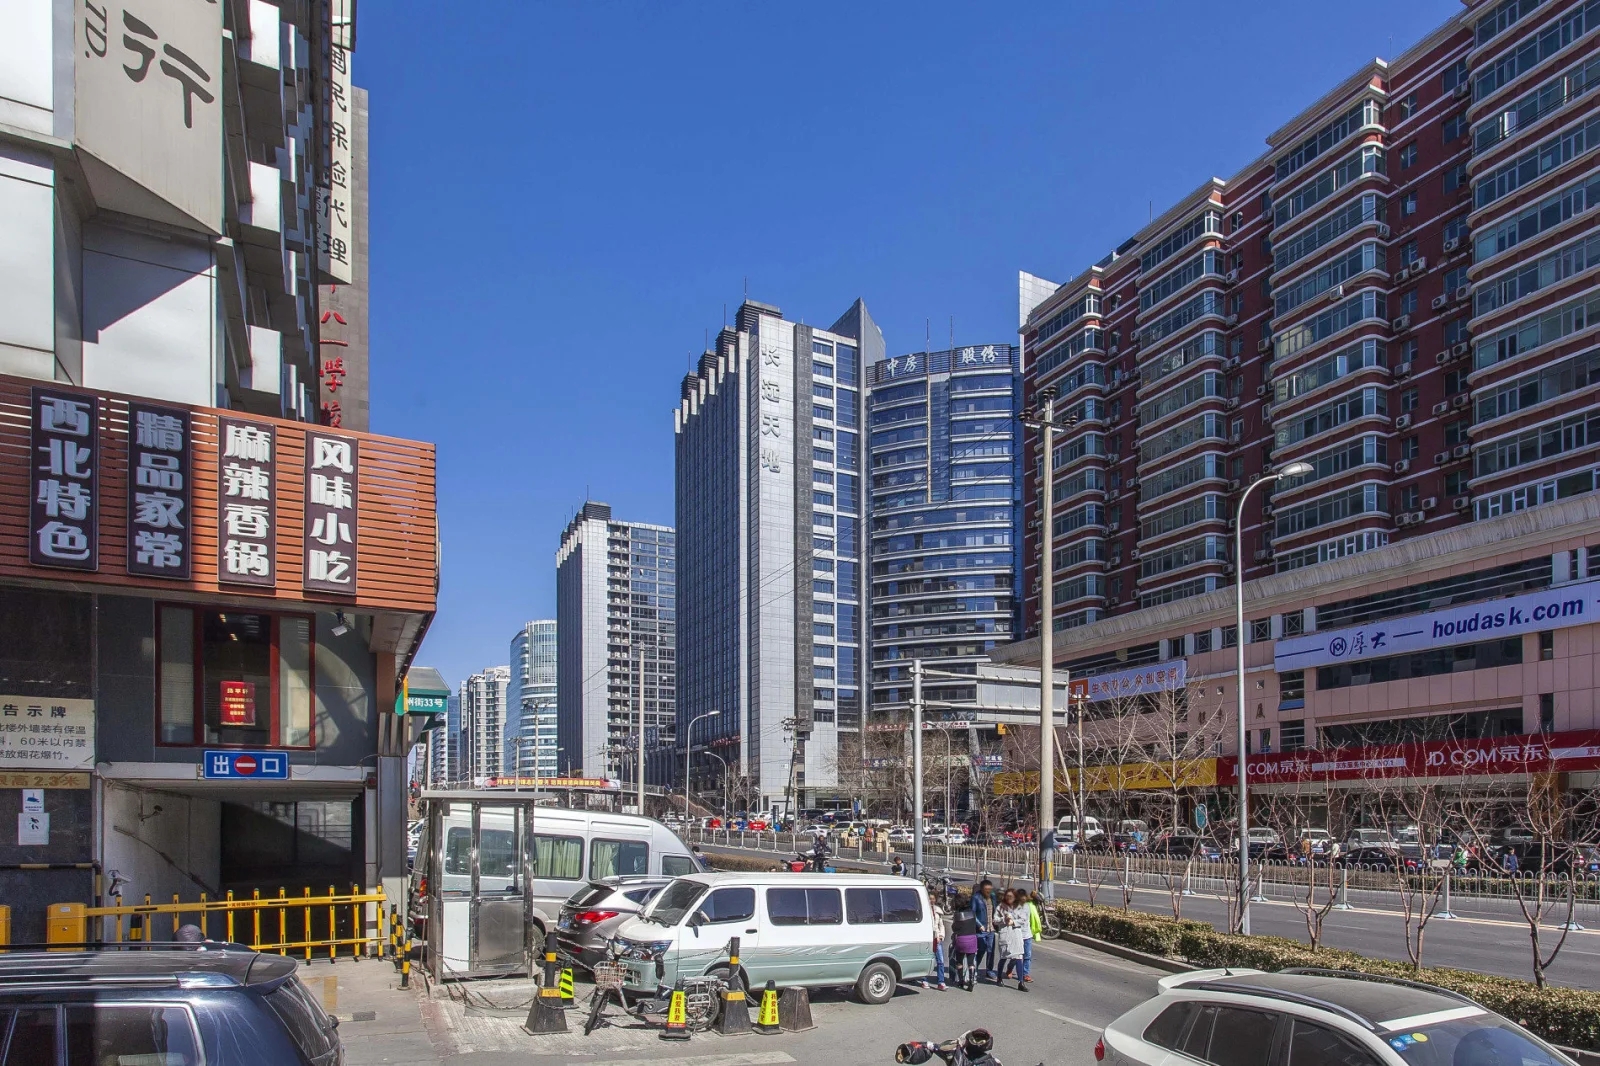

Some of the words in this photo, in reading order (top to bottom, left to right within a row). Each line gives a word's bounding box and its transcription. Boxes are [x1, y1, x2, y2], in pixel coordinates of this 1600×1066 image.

[886, 355, 918, 377] 中房
[961, 344, 1000, 364] 股份
[761, 343, 782, 474] 长远天地
[37, 395, 92, 562] 西北特色
[134, 410, 185, 569] 精品家常
[223, 424, 271, 578] 麻辣香锅
[309, 436, 354, 585] 风味小吃
[1431, 598, 1584, 639] houdask.com
[3, 704, 67, 718] 告示牌
[1500, 743, 1545, 762] 京东
[213, 755, 280, 775] 出口
